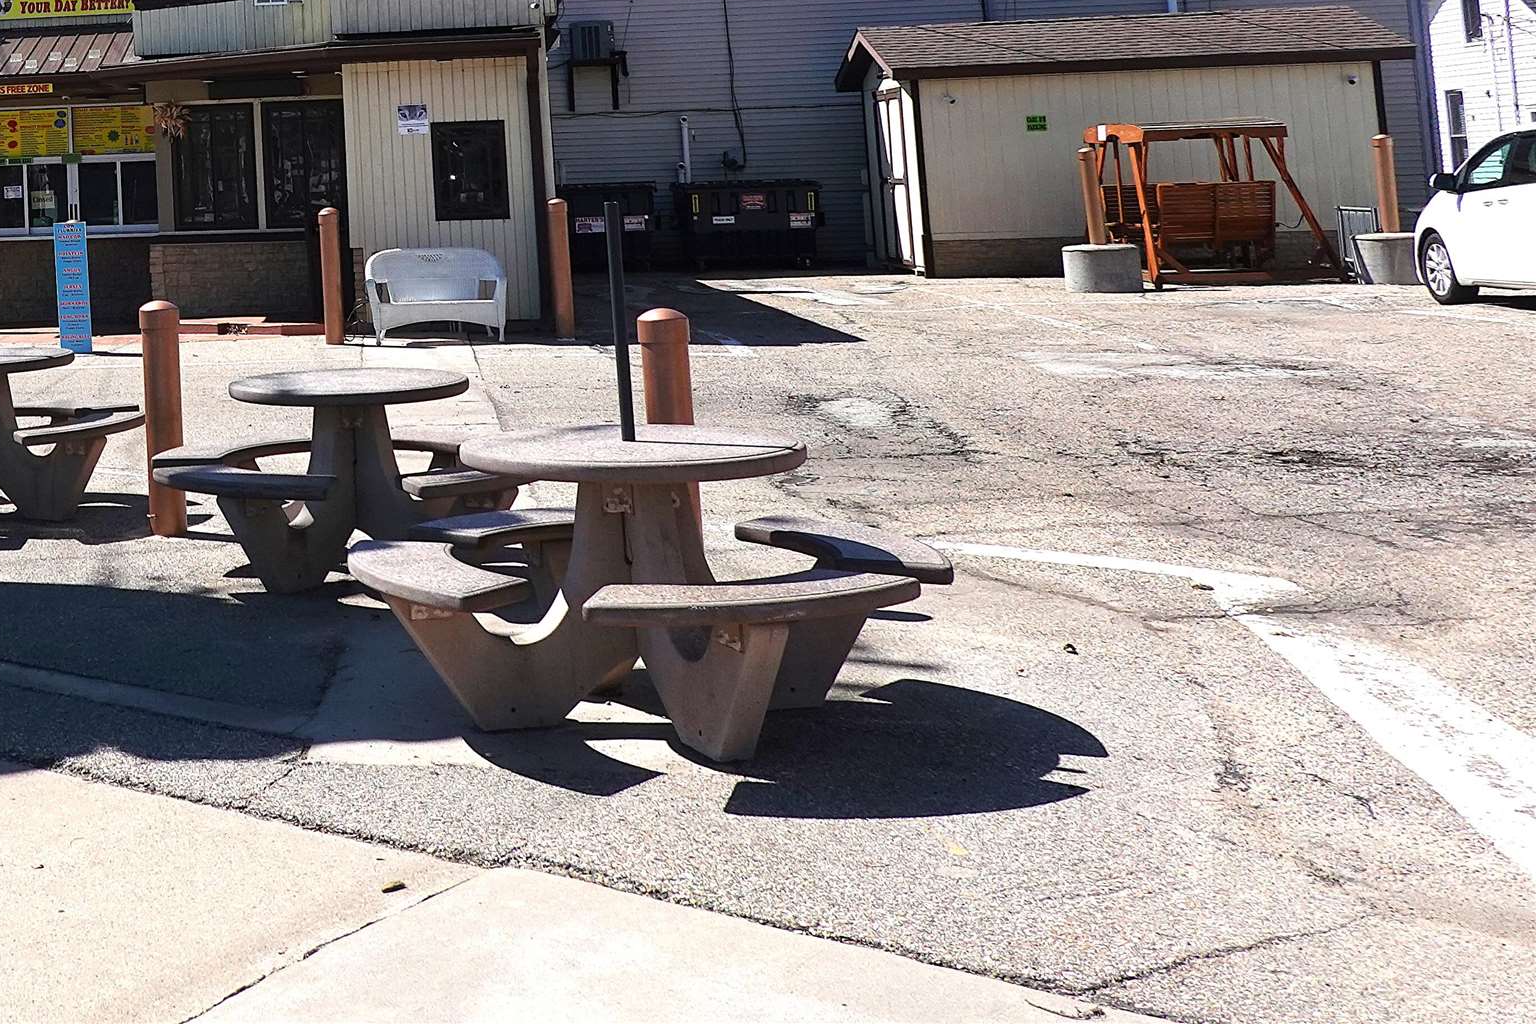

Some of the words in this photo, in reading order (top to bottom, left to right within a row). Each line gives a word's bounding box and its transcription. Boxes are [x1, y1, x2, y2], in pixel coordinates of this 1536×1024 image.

[7, 85, 26, 93] FREE
[27, 84, 50, 93] ZONE
[32, 194, 54, 203] Closed
